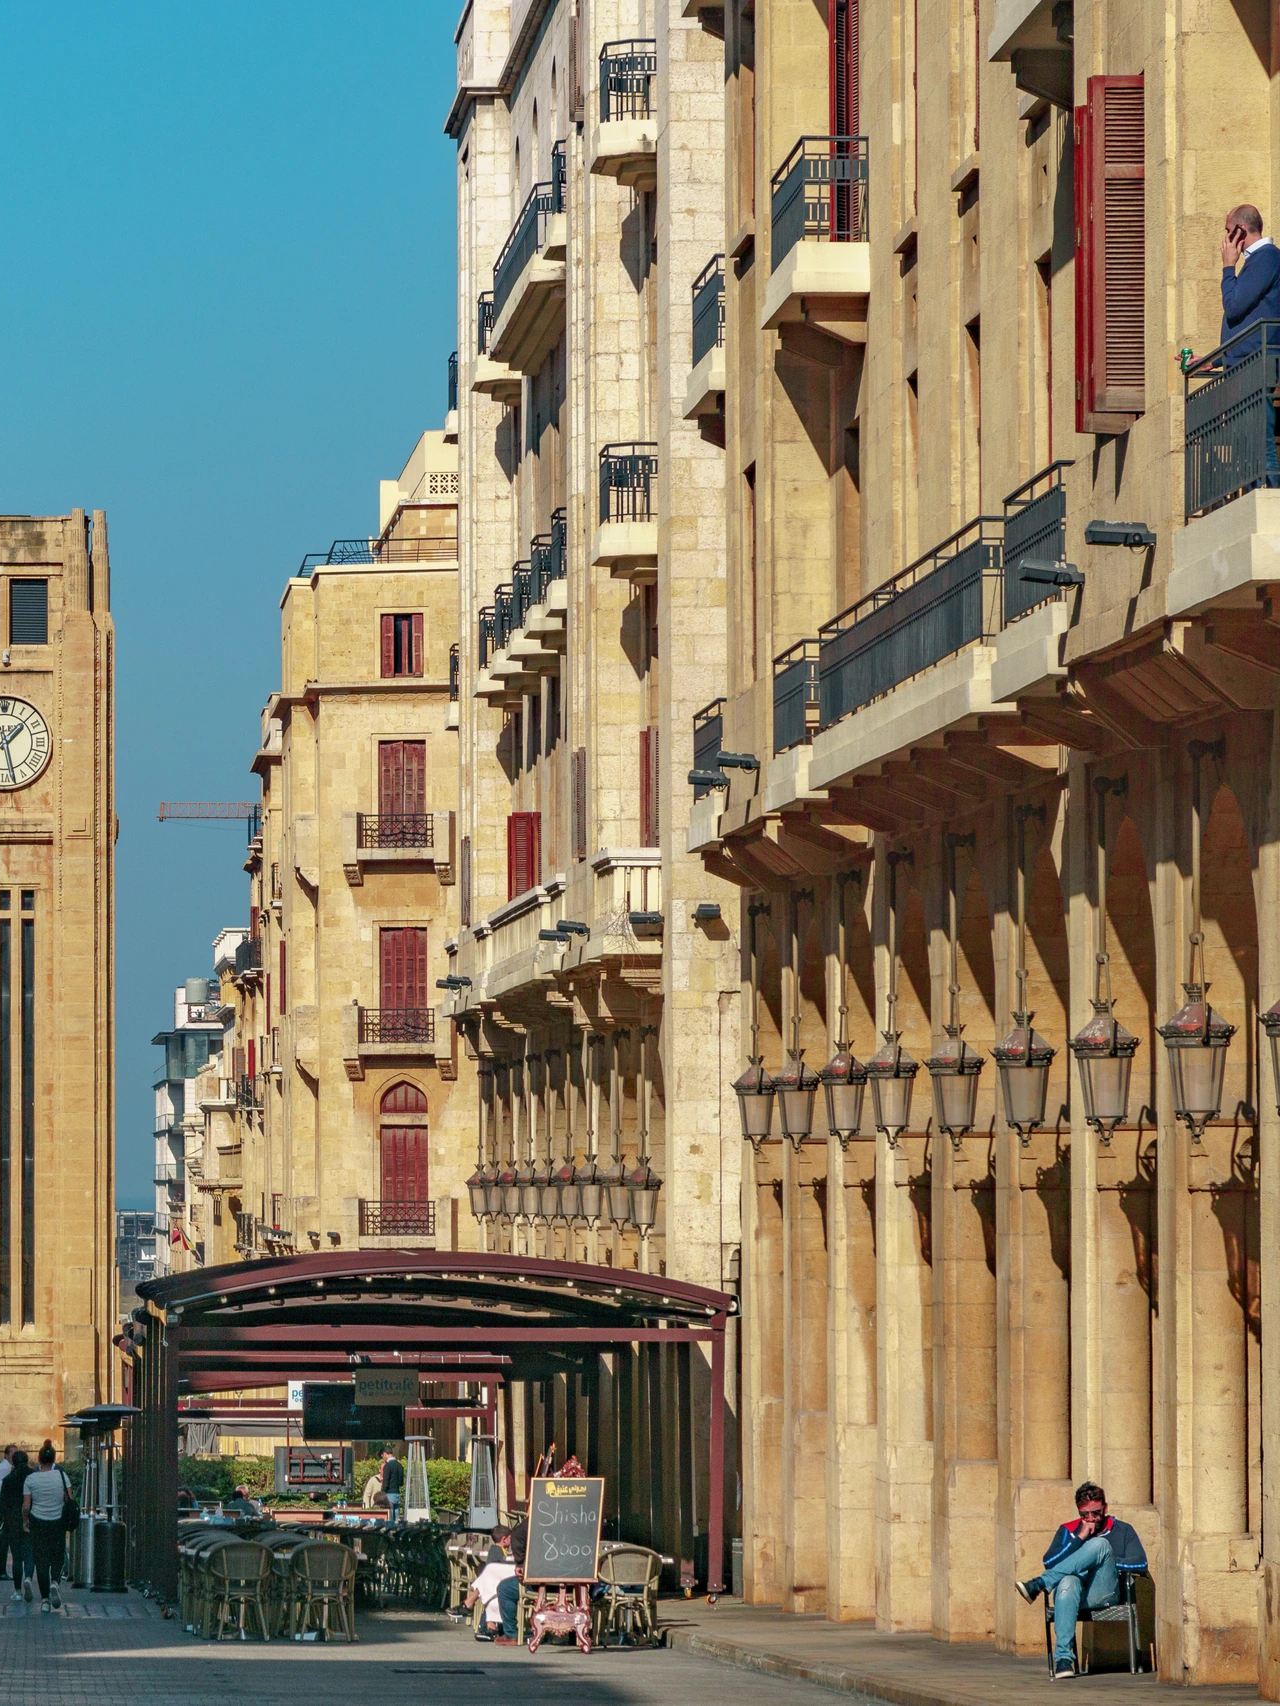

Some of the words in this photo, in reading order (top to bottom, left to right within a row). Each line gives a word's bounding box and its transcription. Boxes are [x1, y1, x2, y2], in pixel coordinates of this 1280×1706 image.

[30, 720, 40, 729] II
[36, 736, 45, 748] III
[537, 1501, 597, 1527] Shisha
